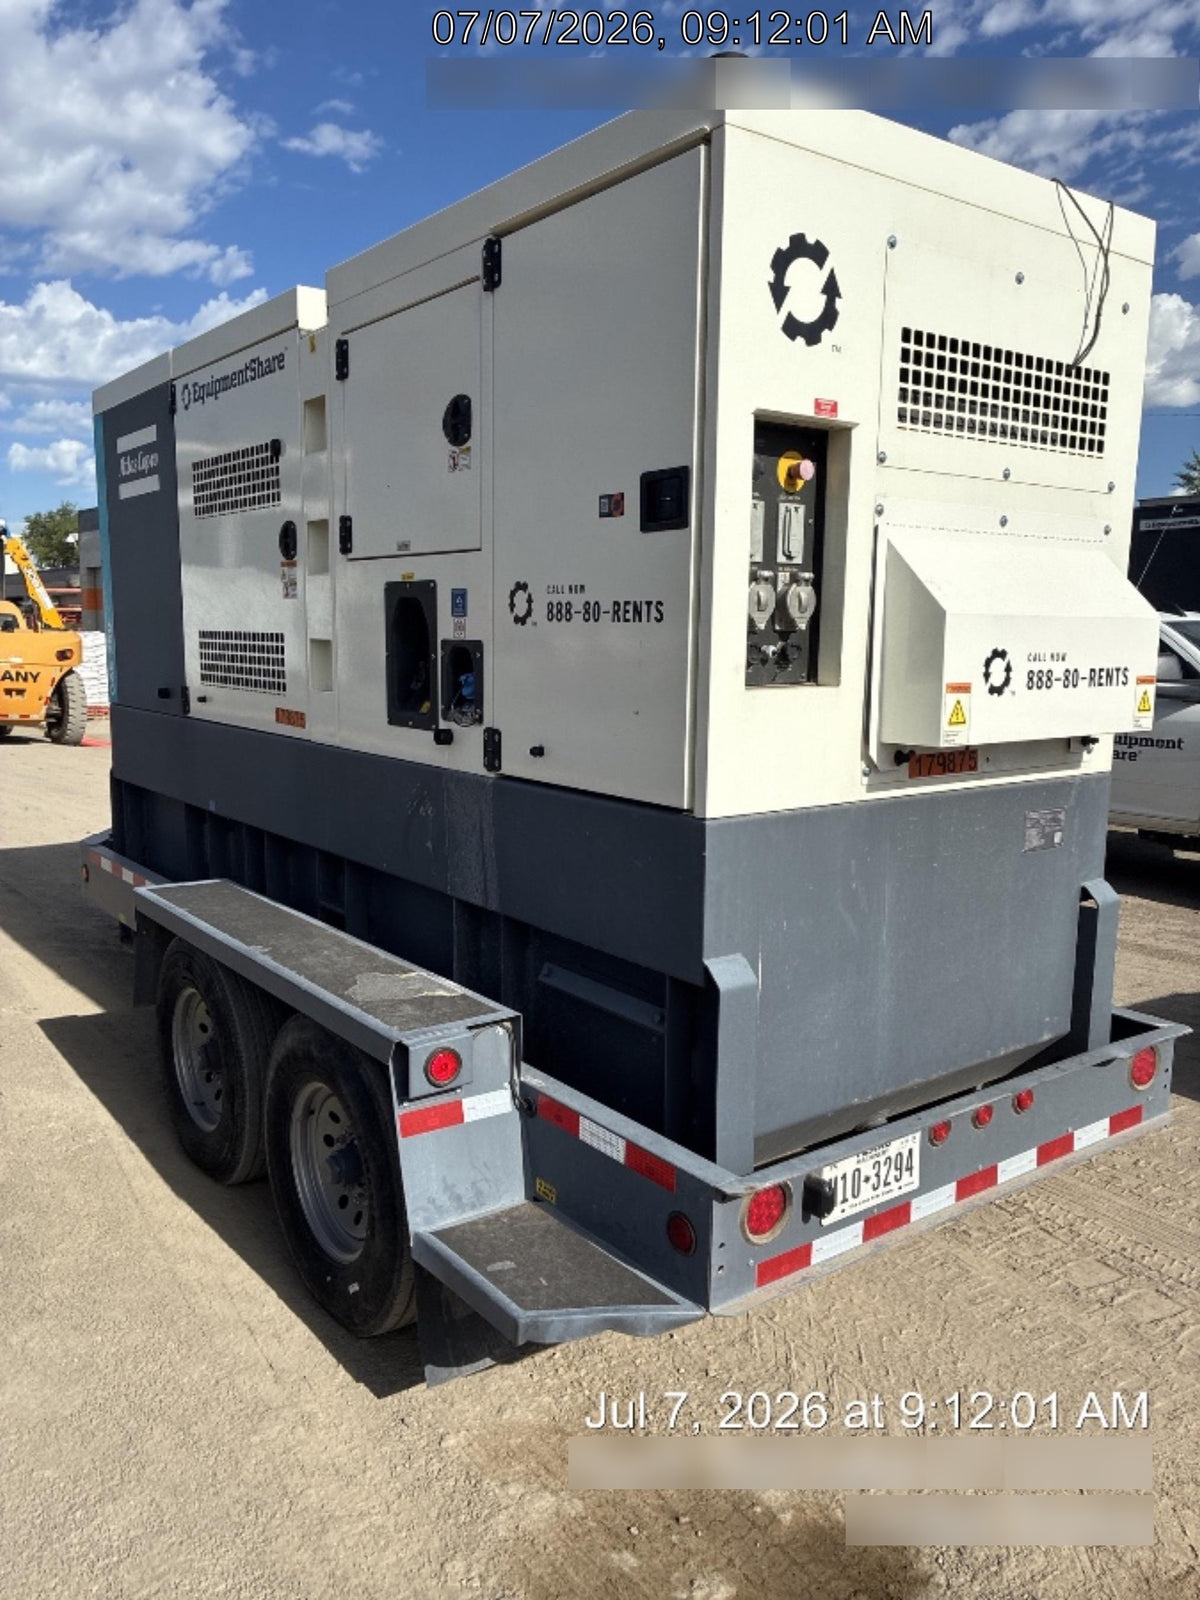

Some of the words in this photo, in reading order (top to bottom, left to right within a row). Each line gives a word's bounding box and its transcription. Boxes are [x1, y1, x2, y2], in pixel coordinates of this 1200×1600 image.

[192, 352, 286, 405] EquipmentShare
[547, 584, 565, 594] CALL
[546, 600, 664, 623] 888-80-RENTS
[1027, 653, 1047, 662] CALL
[1026, 667, 1130, 690] 888-80-RENTS
[1114, 732, 1185, 750] uipment
[915, 750, 978, 777] 179875
[1113, 750, 1137, 761] are
